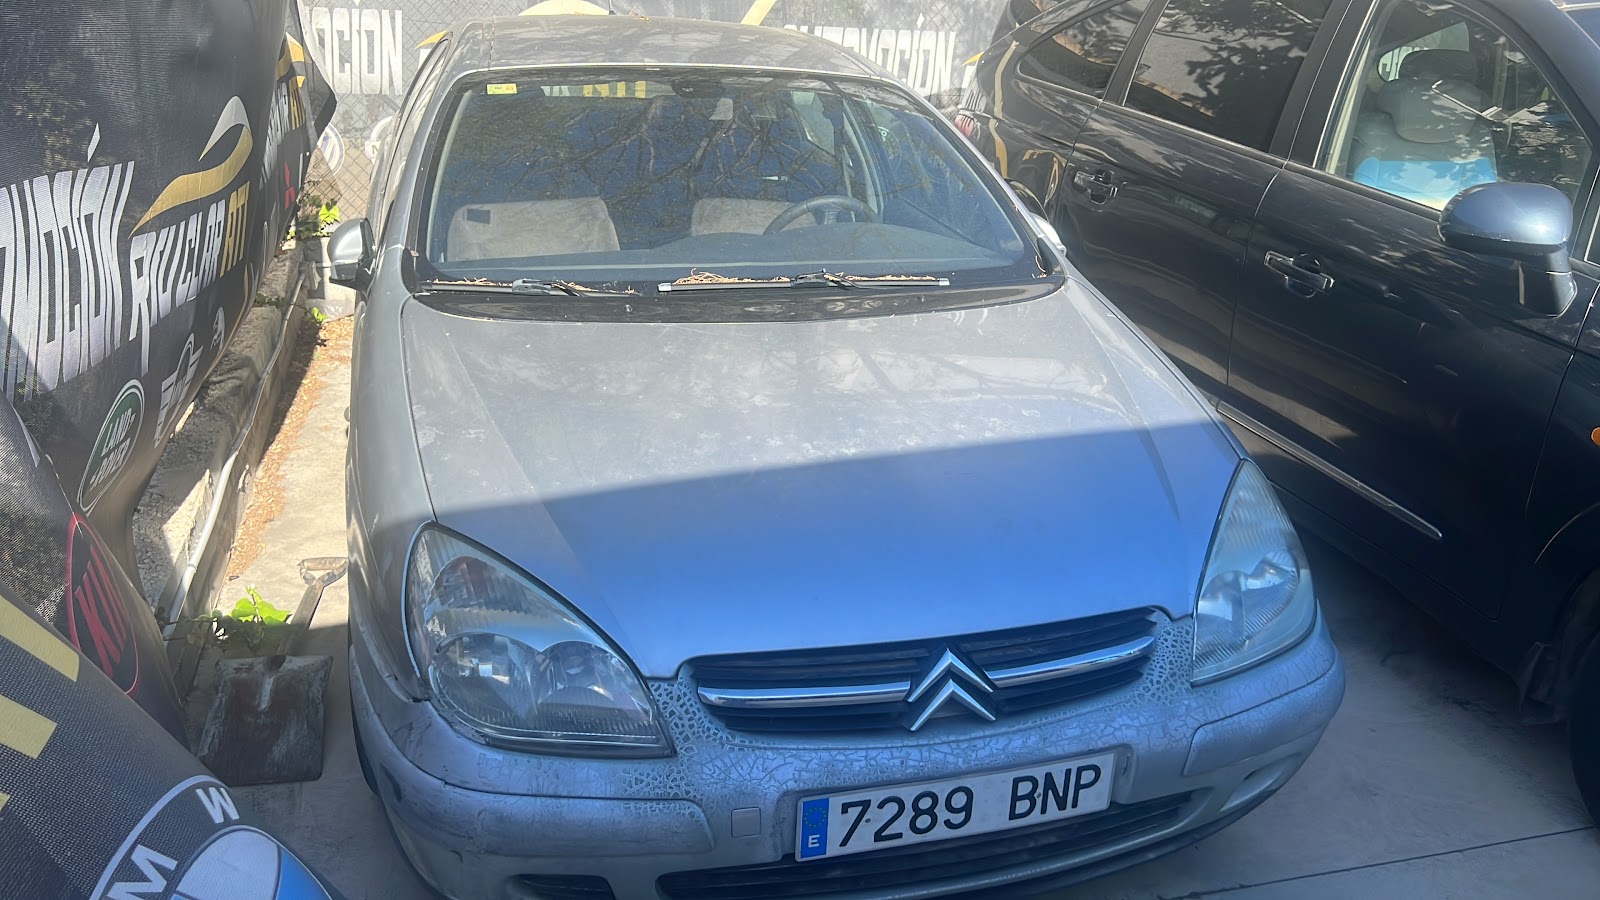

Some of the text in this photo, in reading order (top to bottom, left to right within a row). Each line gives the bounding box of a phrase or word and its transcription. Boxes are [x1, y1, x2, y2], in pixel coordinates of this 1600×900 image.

[307, 0, 403, 95] OCIÓN
[106, 786, 240, 900] MW
[807, 834, 820, 848] E
[838, 763, 1101, 848] 7289 BNP
